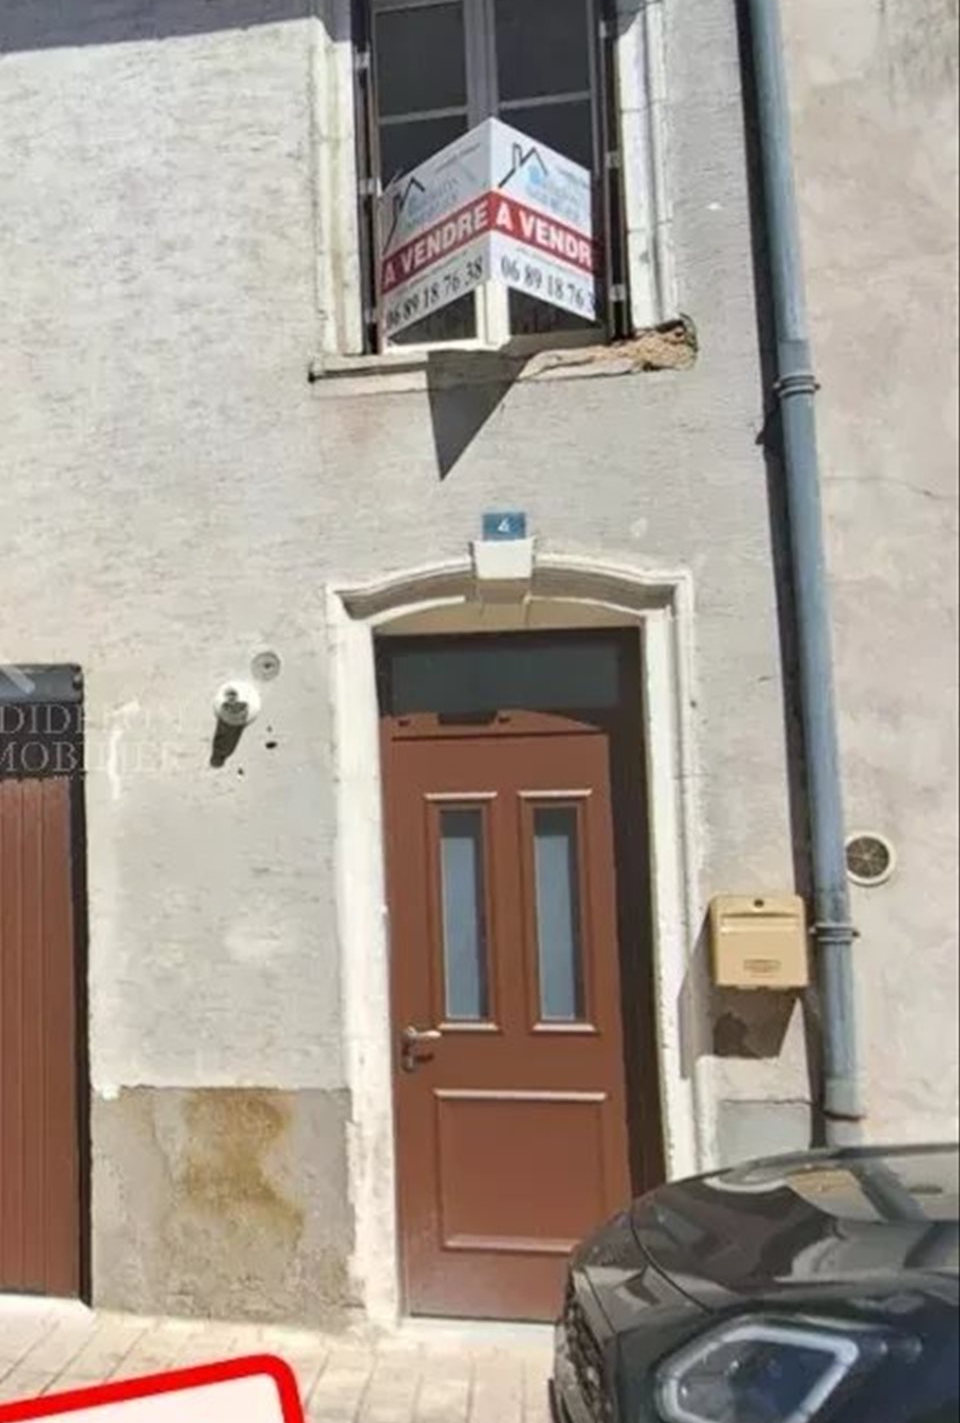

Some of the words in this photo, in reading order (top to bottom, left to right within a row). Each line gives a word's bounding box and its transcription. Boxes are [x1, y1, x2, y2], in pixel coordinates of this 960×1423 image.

[384, 261, 397, 290] A
[399, 200, 489, 275] VENDRE
[495, 200, 514, 233] A
[518, 208, 593, 271] VENDR
[422, 281, 440, 310] 18
[442, 271, 462, 297] 76
[465, 255, 483, 287] 38
[500, 254, 521, 283] 06
[523, 265, 543, 290] 89
[546, 274, 565, 300] 18
[566, 282, 585, 309] 76
[497, 516, 510, 533] 4
